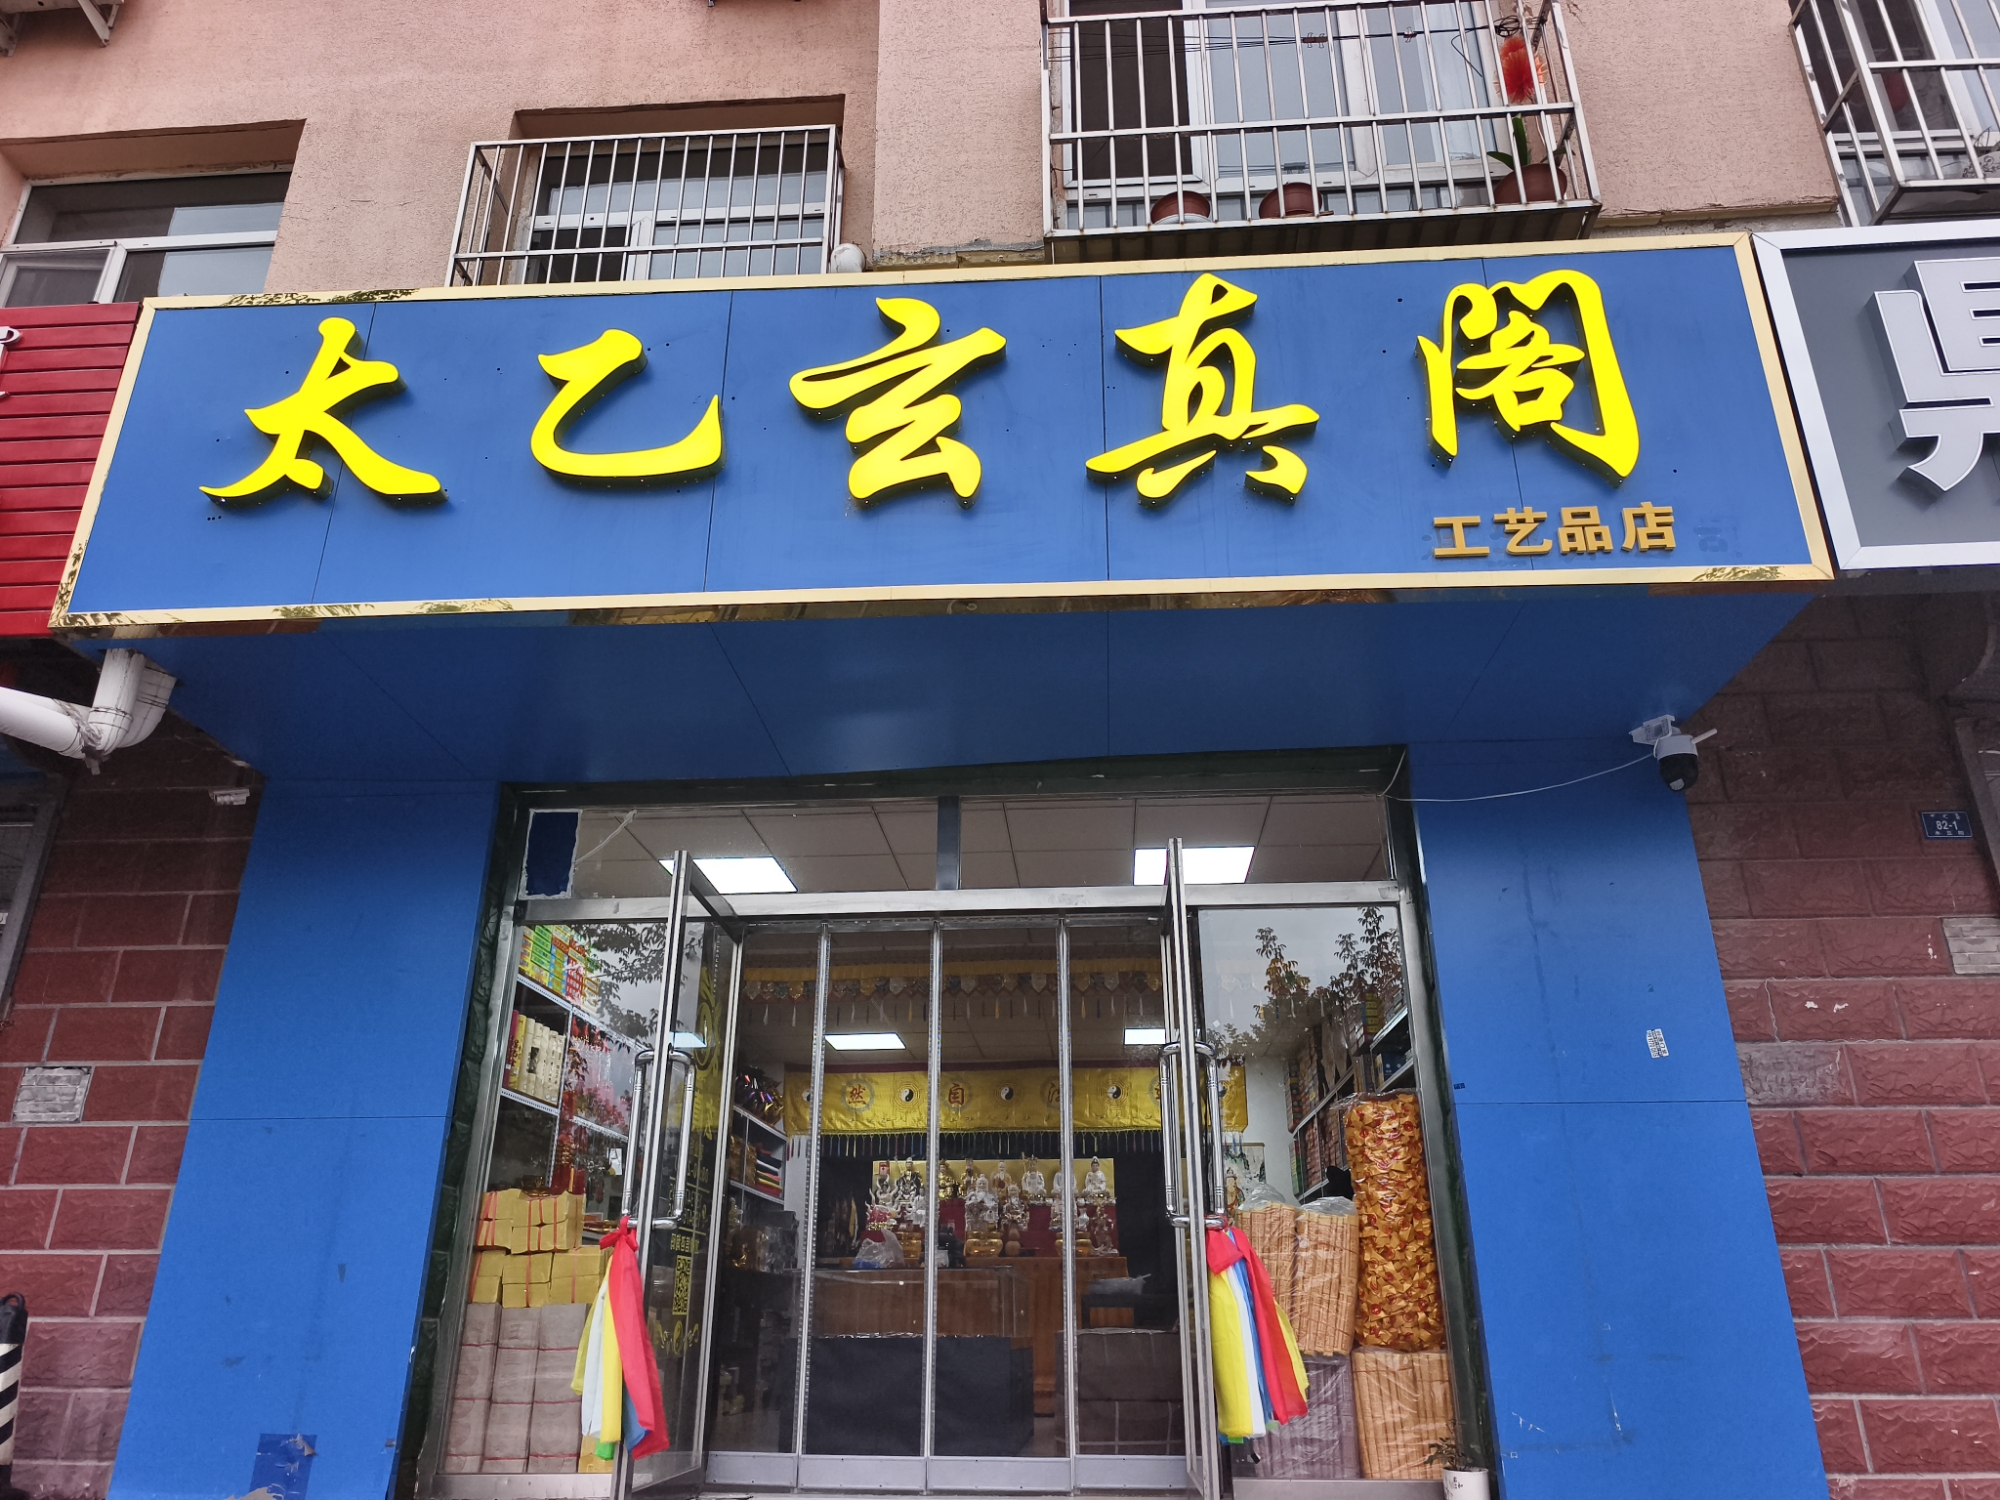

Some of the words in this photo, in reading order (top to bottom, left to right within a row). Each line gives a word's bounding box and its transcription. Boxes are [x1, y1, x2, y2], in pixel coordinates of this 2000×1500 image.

[1434, 501, 1676, 558] 工艺品店
[1935, 820, 1958, 830] 82-1
